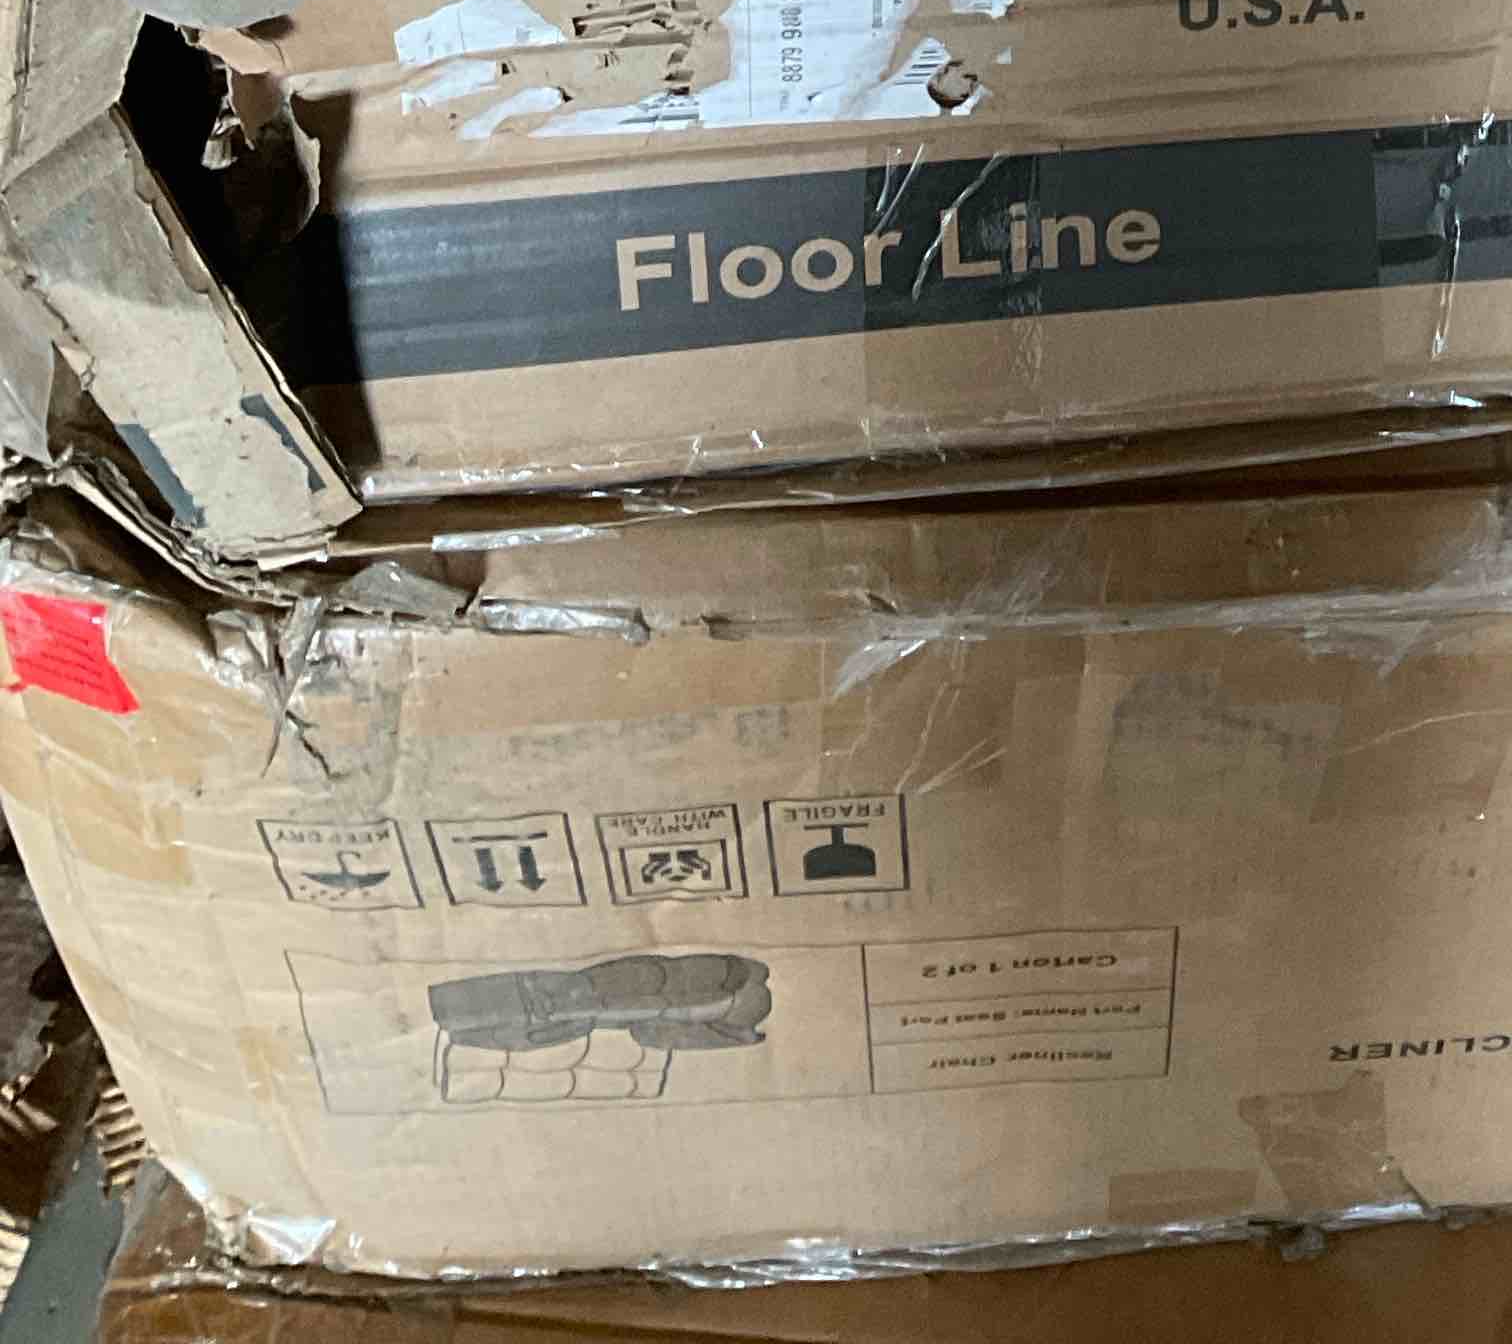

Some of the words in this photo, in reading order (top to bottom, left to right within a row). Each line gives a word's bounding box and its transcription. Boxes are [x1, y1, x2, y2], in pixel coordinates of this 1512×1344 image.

[781, 47, 803, 82] 8879
[615, 228, 902, 312] Floor
[939, 200, 1161, 281] Line
[782, 803, 886, 823] FRAGILE
[920, 963, 939, 979] 2
[947, 963, 978, 977] of
[988, 961, 1002, 974] 1
[1011, 954, 1118, 972] Carton
